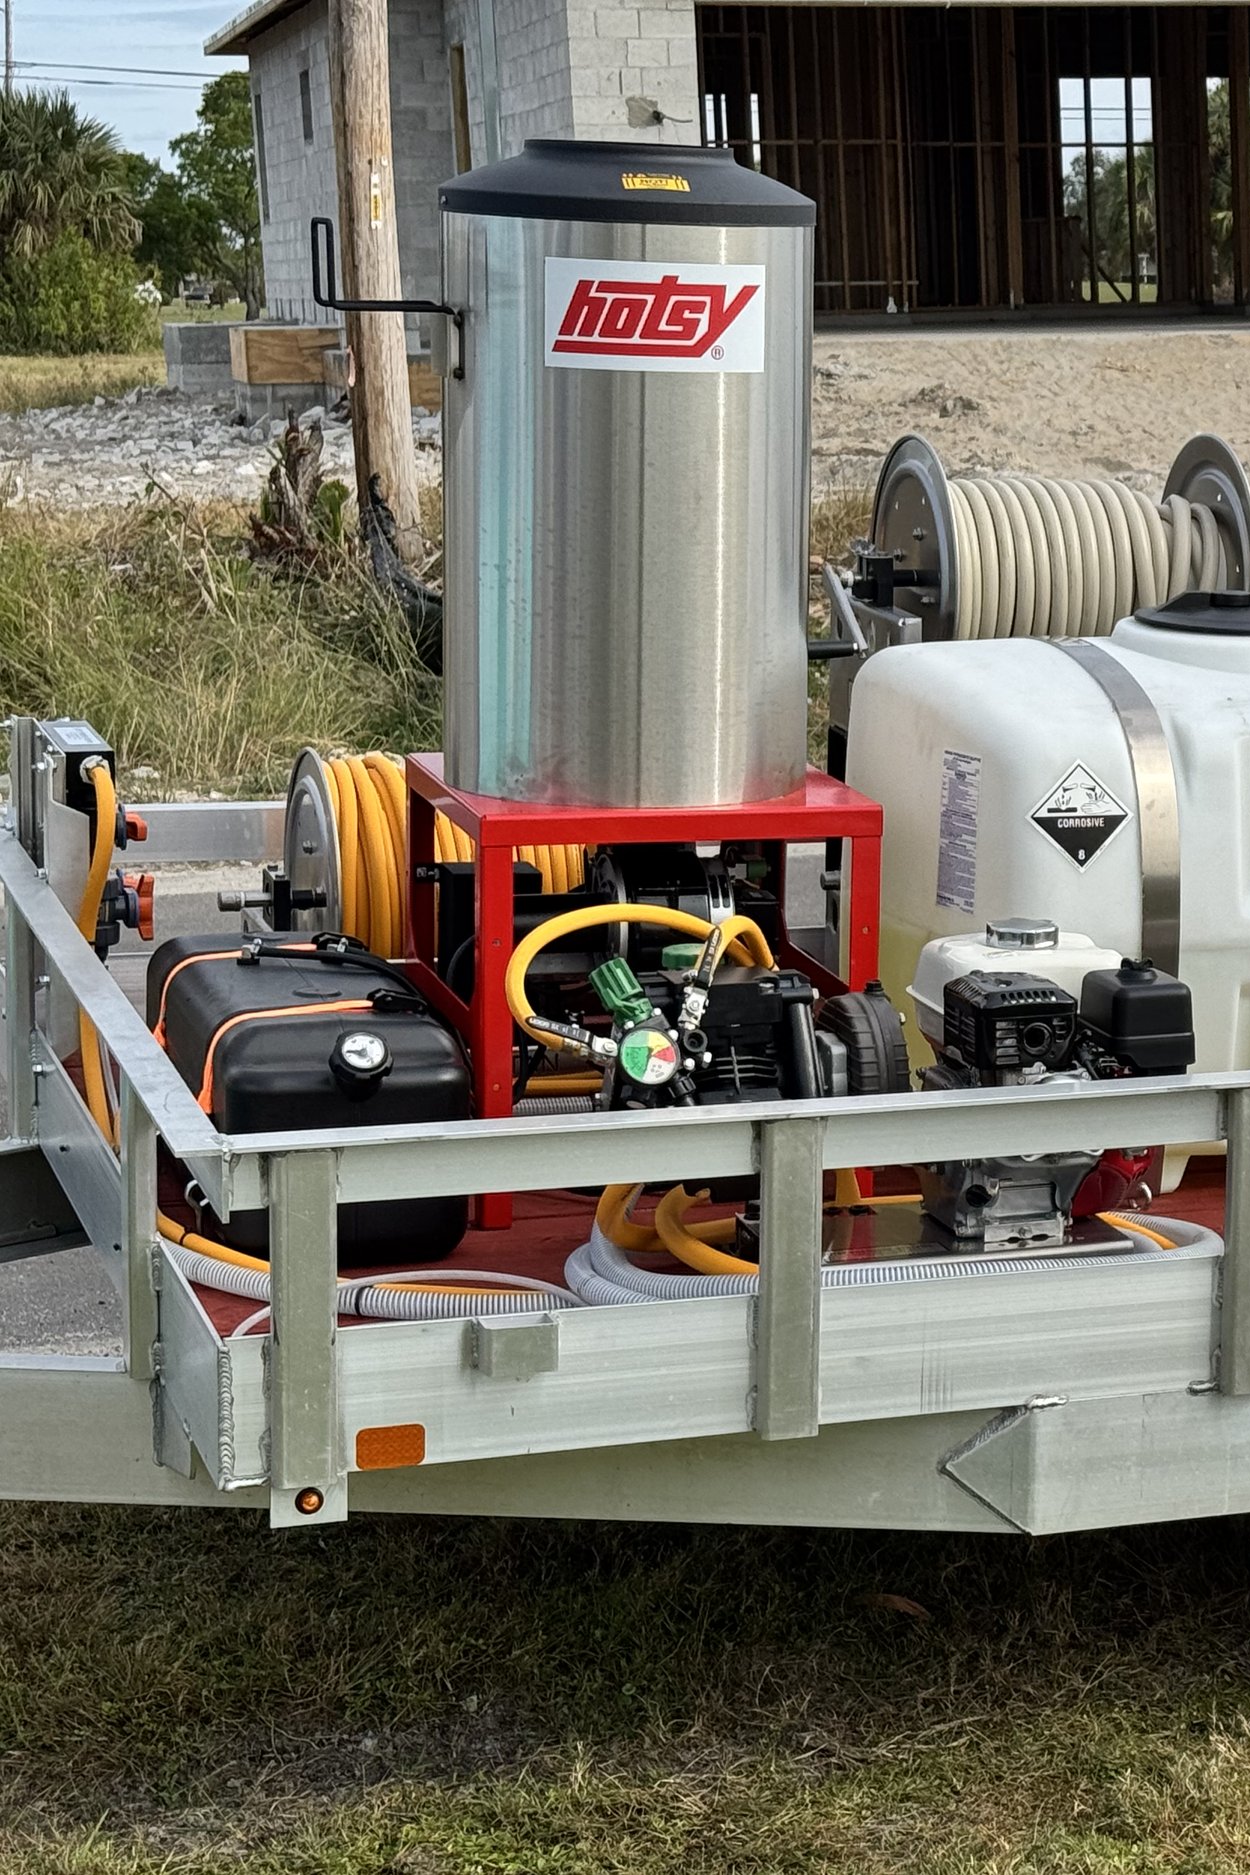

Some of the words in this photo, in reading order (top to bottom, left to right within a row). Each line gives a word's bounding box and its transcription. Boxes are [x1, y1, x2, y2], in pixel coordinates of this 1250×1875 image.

[552, 275, 760, 357] hotsy
[1057, 817, 1105, 828] CORROSIVE
[1078, 849, 1086, 860] 8
